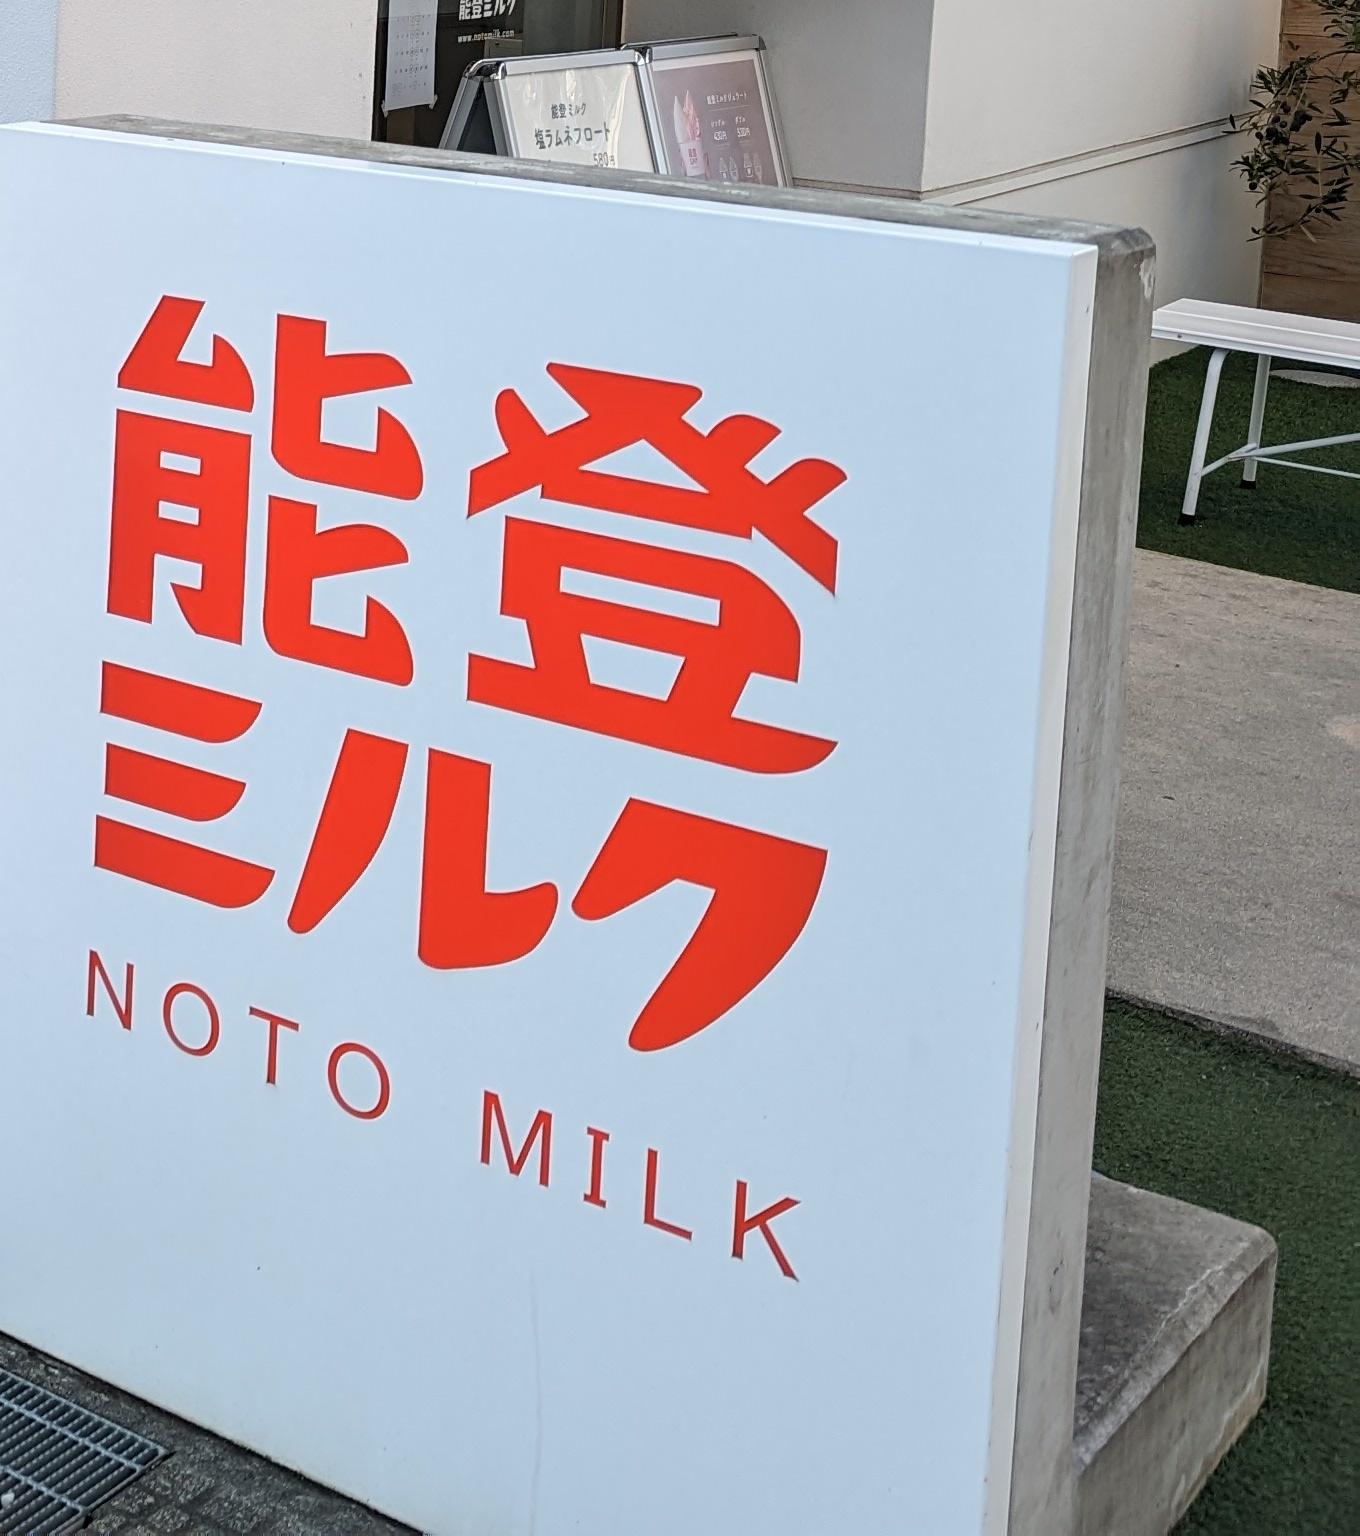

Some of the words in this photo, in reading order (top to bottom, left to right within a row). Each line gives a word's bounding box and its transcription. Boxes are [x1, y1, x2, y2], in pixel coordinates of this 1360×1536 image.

[534, 121, 611, 150] 塩ラムネフロート
[550, 102, 587, 120] 能登ミルク
[106, 294, 848, 775] 能登
[93, 660, 829, 1053] ミルク
[85, 947, 393, 1121] NOTO
[478, 1089, 802, 1282] MILK
